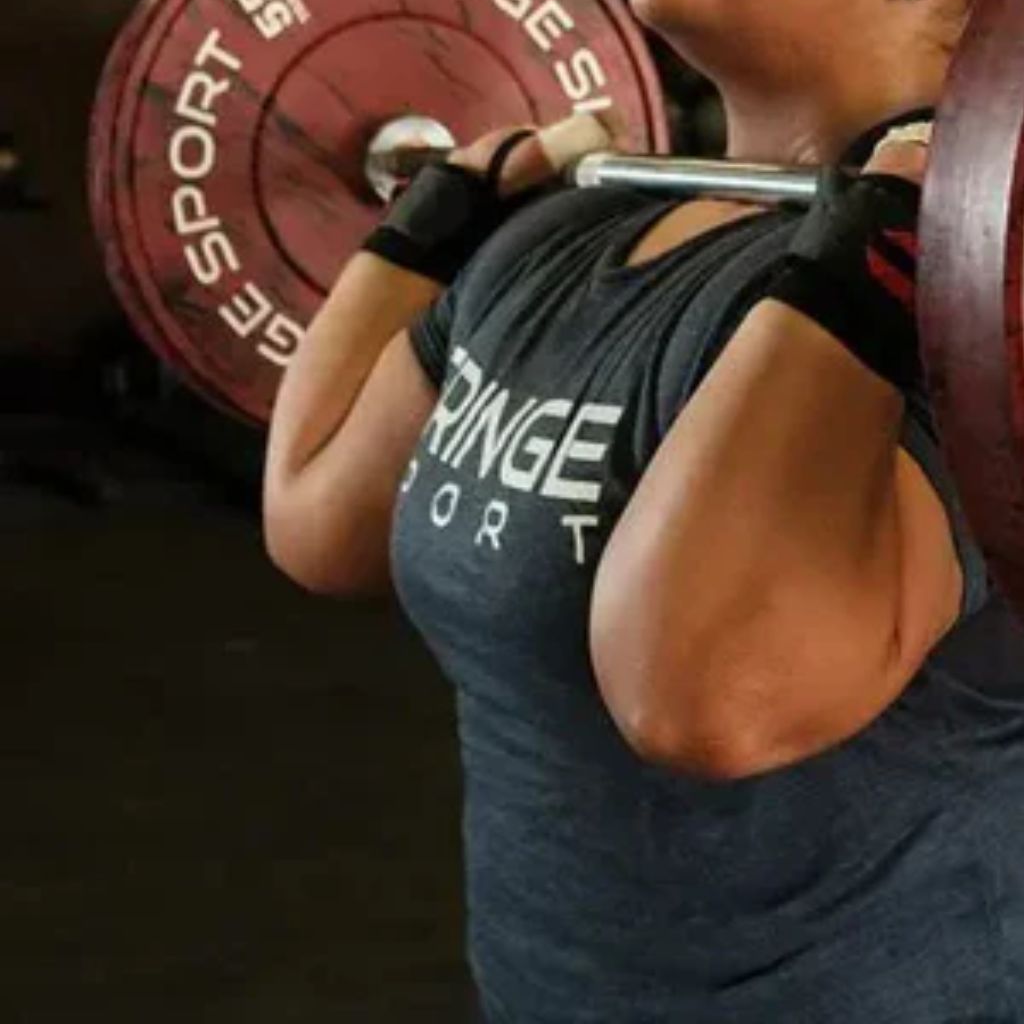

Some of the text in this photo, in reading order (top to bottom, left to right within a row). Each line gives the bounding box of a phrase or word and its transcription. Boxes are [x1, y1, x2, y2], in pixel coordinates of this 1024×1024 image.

[169, 29, 242, 286] SPORT
[428, 346, 624, 503] RINGE
[401, 458, 600, 564] ORT
